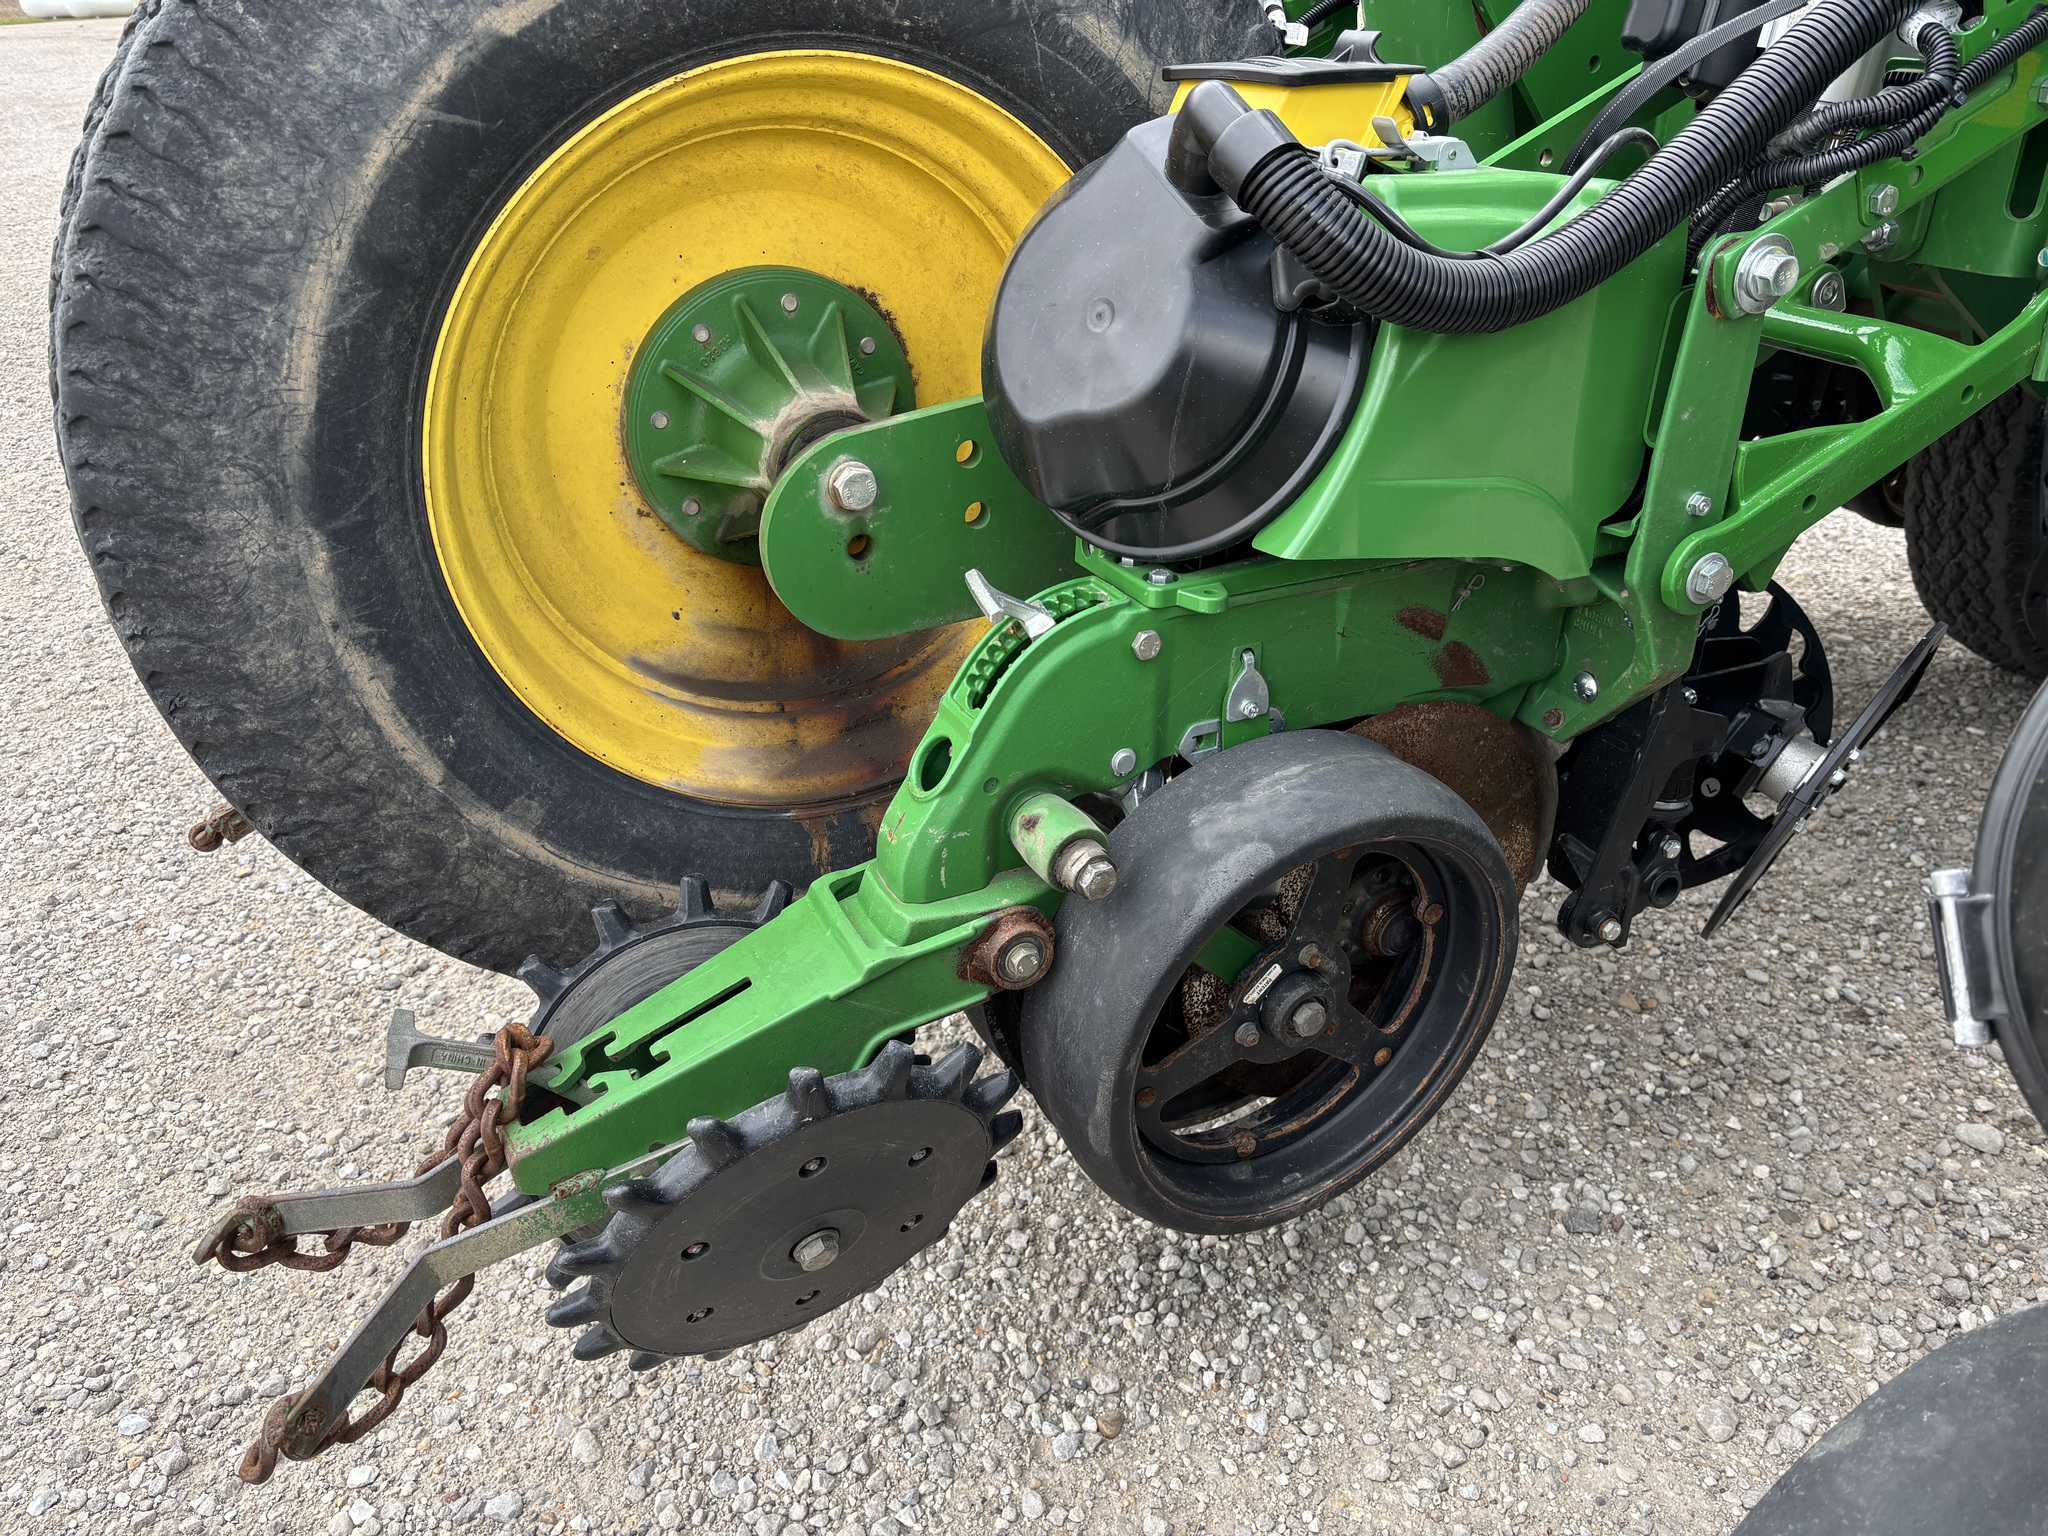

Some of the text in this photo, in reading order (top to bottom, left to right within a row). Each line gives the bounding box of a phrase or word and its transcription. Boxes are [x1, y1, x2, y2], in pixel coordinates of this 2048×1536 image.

[1573, 618, 1602, 640] CHINA
[1256, 978, 1273, 996] PATENT
[440, 1053, 473, 1065] CHINA
